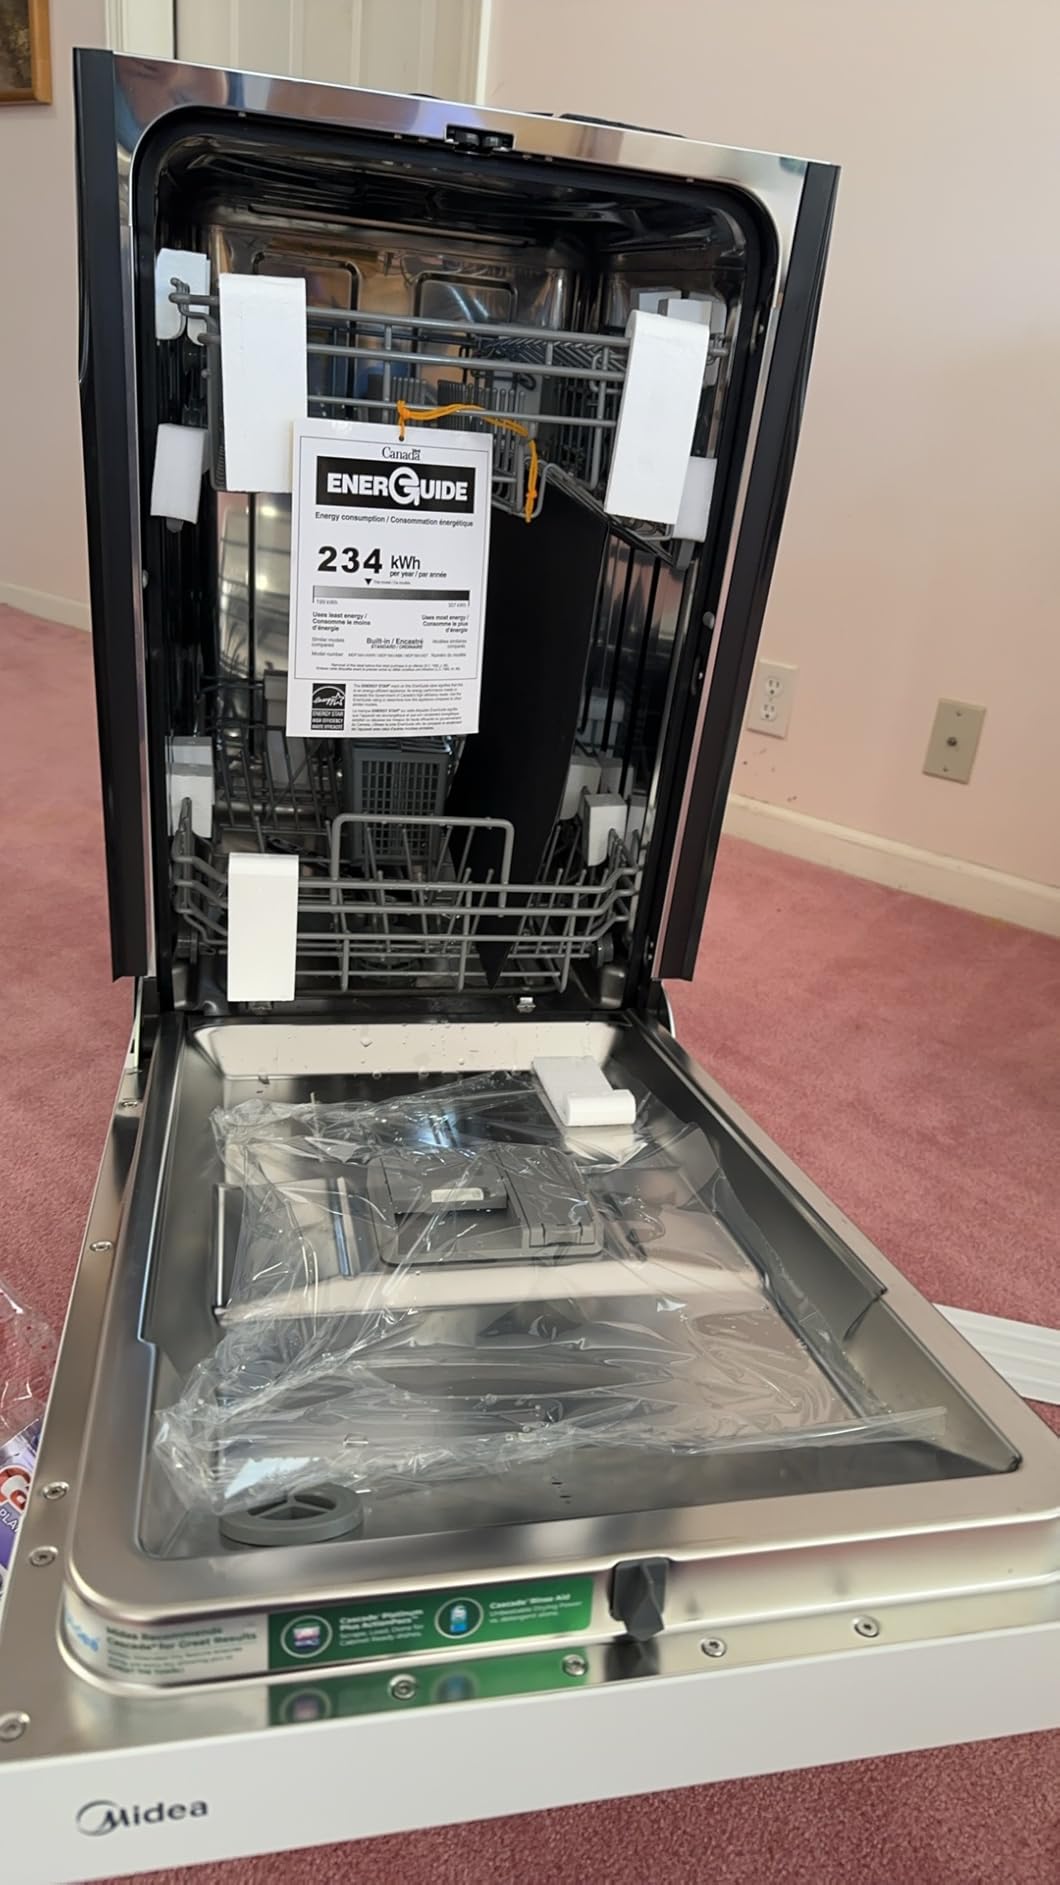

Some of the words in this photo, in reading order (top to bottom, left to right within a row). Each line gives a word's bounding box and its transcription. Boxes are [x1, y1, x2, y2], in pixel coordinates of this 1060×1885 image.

[382, 446, 421, 461] Canada
[327, 467, 468, 506] ENERGUIDE
[315, 511, 340, 521] Energy
[341, 513, 385, 523] consumption
[390, 516, 438, 525] Consommation
[317, 546, 383, 574] 234
[390, 555, 421, 570] kWh
[401, 571, 414, 579] year
[0, 1508, 20, 1532] PLA
[76, 1799, 208, 1837] Midea
